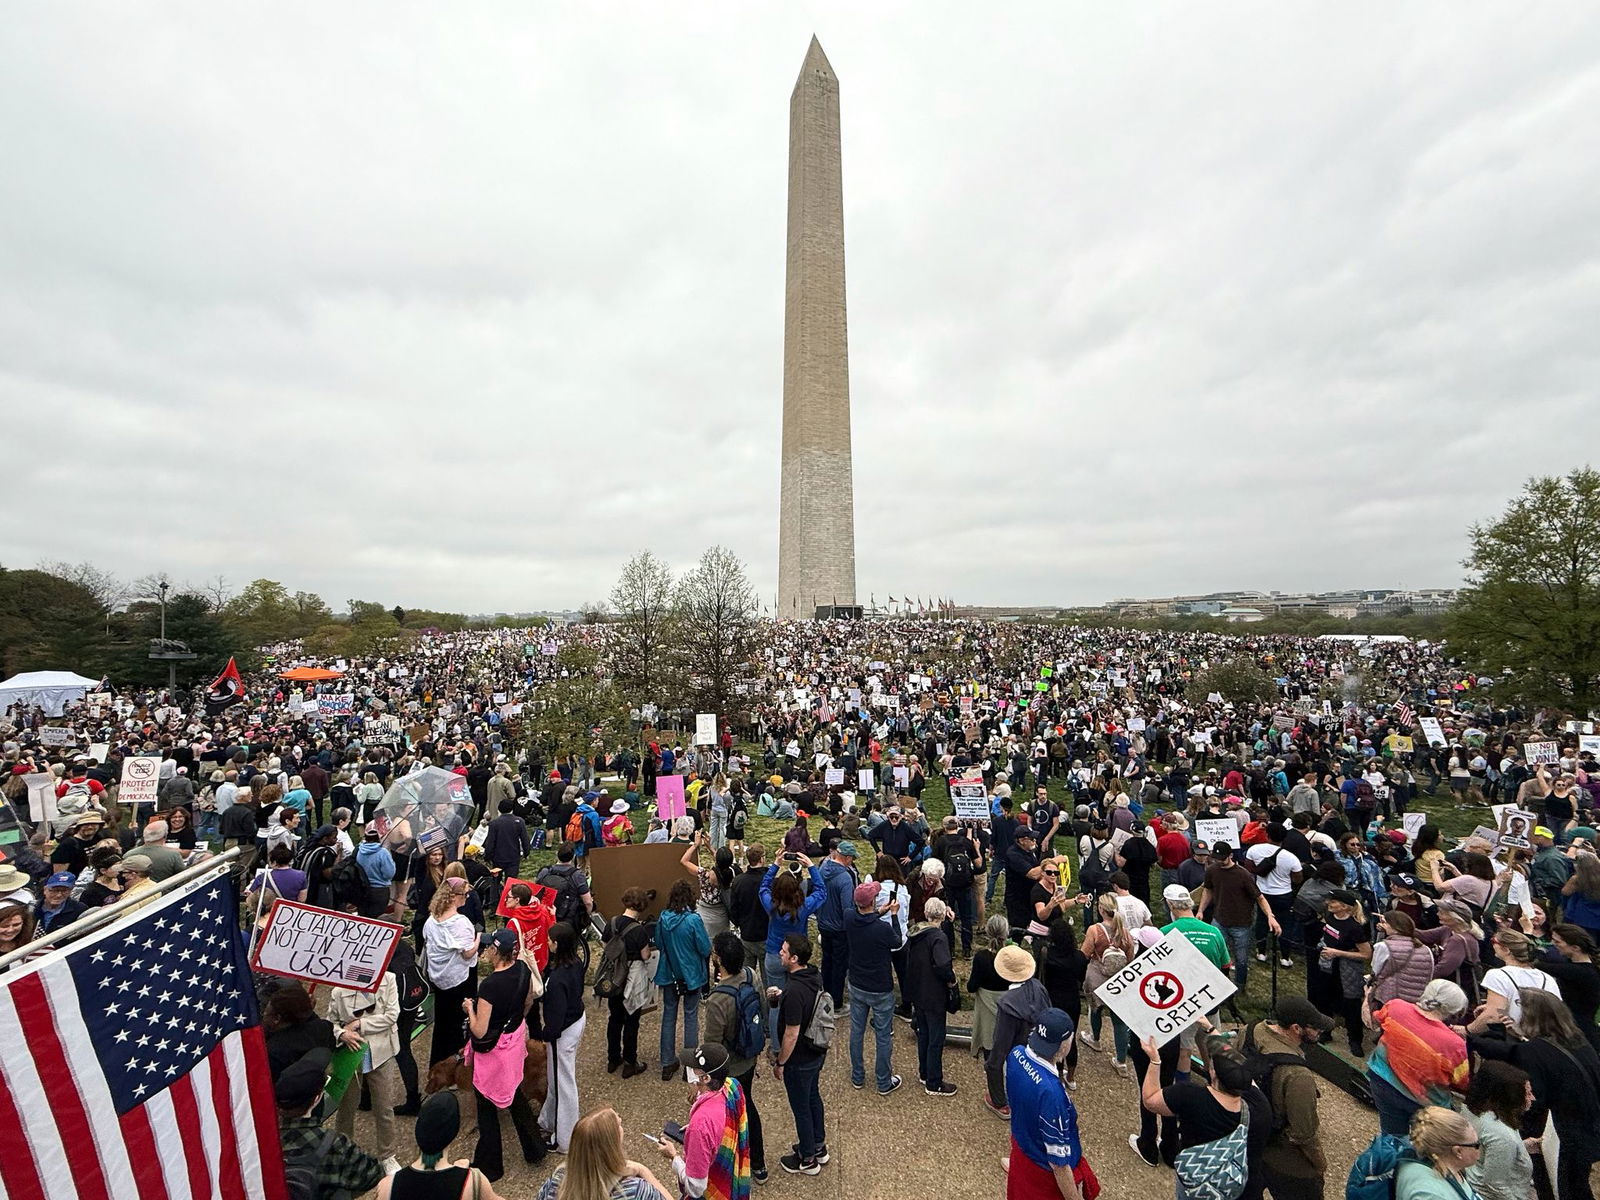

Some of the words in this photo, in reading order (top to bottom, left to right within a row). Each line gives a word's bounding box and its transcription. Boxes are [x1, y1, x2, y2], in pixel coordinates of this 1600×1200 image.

[320, 694, 349, 702] MAKE
[1320, 715, 1344, 724] HANDS
[1325, 722, 1340, 731] OFF
[1539, 742, 1556, 750] NOT
[121, 780, 156, 788] PROTECT
[275, 906, 394, 947] DICTATORSHIP
[267, 926, 305, 949] NOT
[304, 933, 335, 955] IN
[340, 939, 377, 964] THE
[289, 951, 344, 980] USA
[1106, 962, 1143, 995] STOP
[1142, 941, 1174, 966] THE
[1155, 984, 1216, 1034] GRIFT
[1012, 1049, 1022, 1059] AN
[1018, 1056, 1043, 1085] CABHÁN
